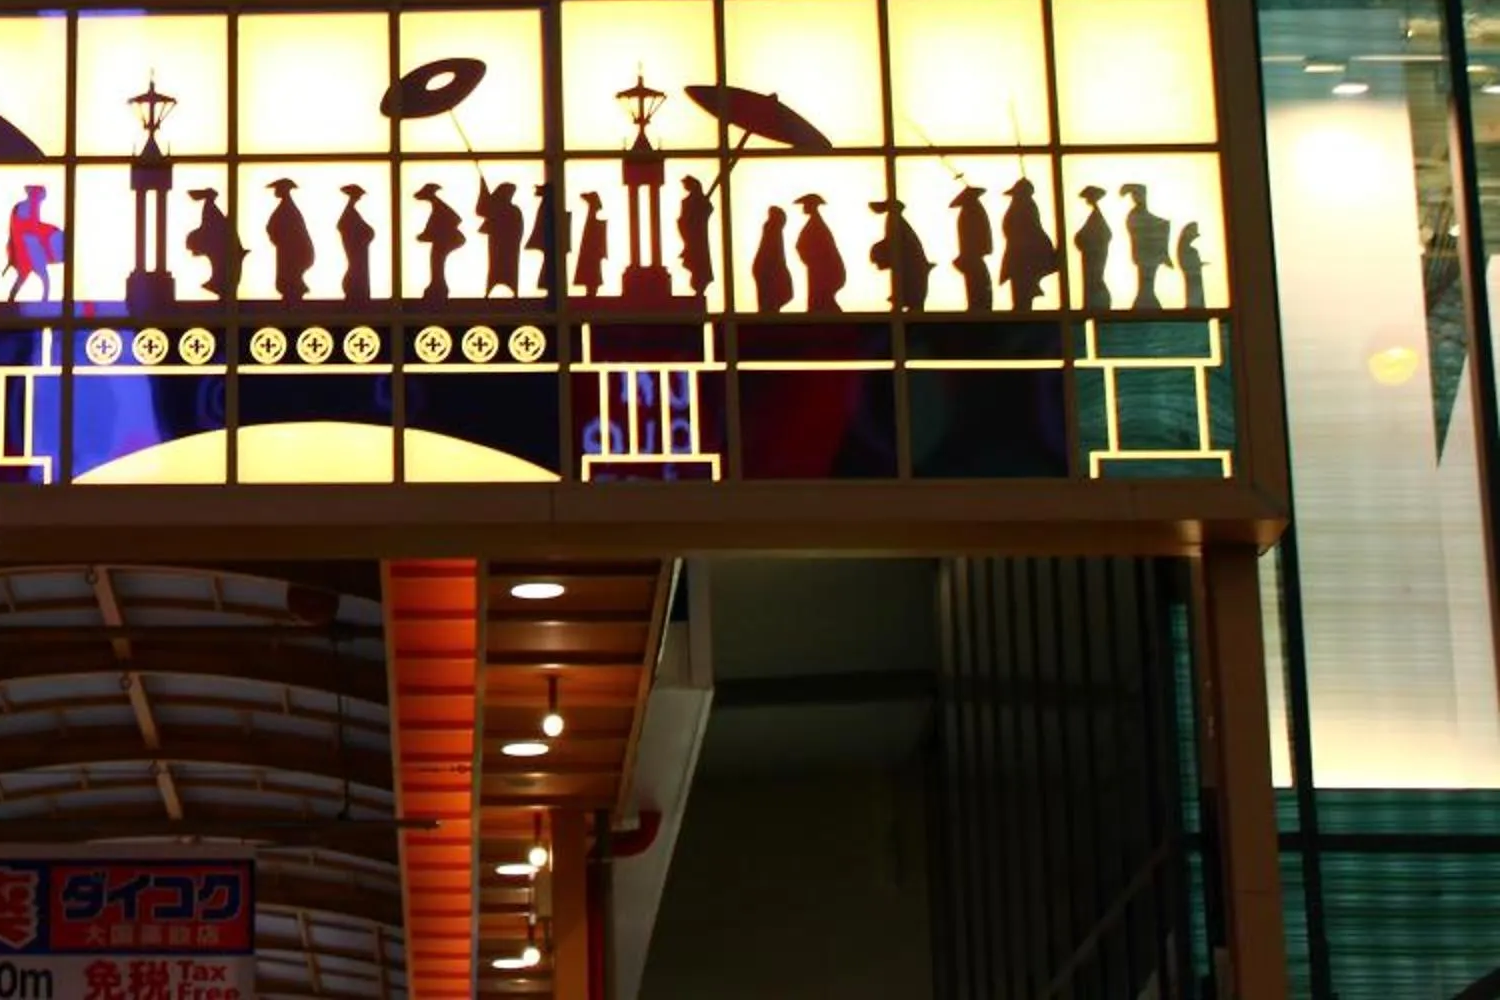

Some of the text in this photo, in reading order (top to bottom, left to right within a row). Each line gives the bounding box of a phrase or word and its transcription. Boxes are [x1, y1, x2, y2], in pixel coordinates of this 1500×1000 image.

[62, 871, 243, 921] ダイコク
[85, 959, 169, 1000] 免税
[178, 960, 228, 982] Tax
[177, 983, 241, 1000] Free
